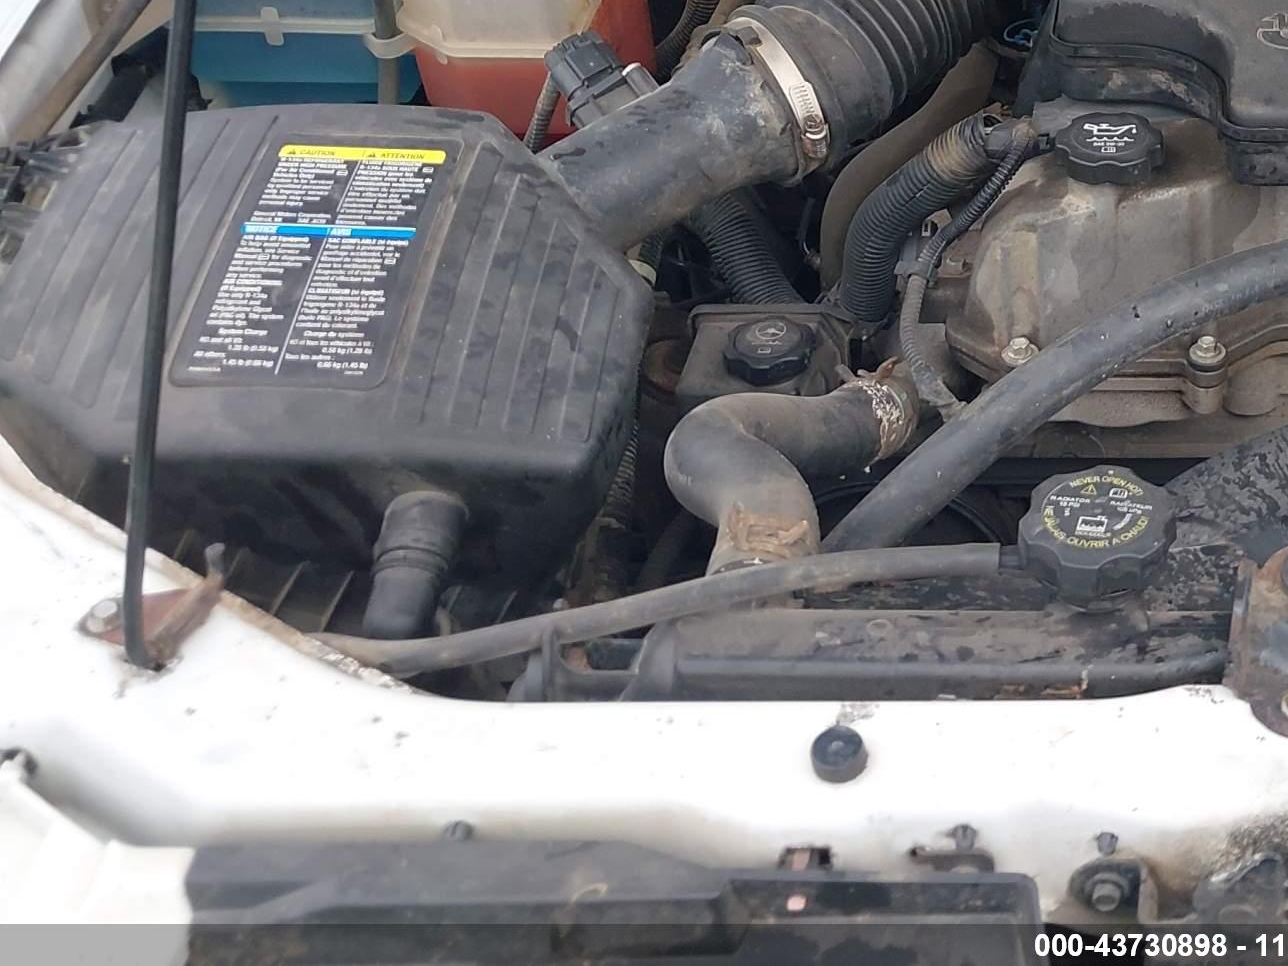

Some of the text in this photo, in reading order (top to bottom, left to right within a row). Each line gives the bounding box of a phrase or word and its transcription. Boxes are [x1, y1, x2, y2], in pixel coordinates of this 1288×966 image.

[245, 225, 277, 233] NOTICE
[330, 228, 352, 236] AVIS
[1069, 476, 1101, 488] NEVER
[1101, 475, 1127, 487] OPEN
[1050, 495, 1090, 503] RADIATOR
[1066, 535, 1110, 549] OUVRIR
